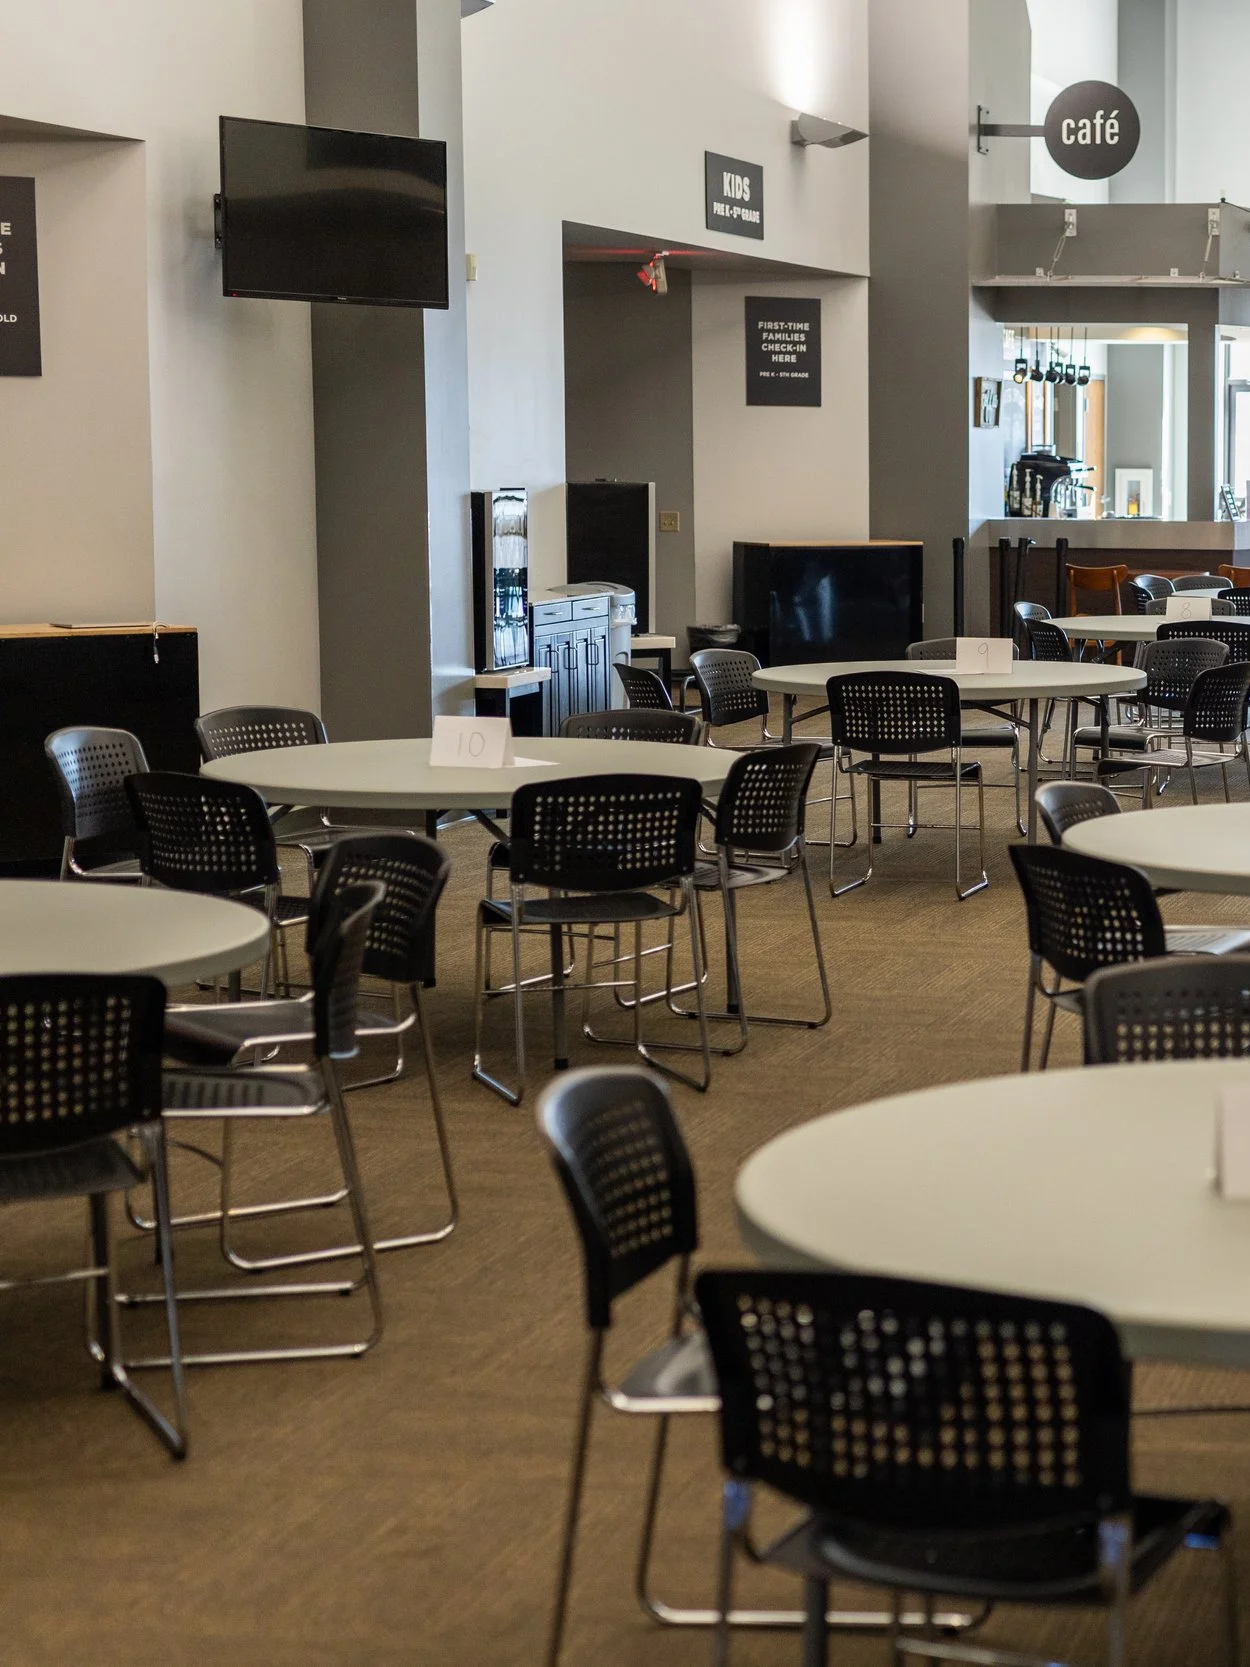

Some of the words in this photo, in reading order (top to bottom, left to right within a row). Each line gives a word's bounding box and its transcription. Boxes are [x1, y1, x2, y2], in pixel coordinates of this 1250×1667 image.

[1061, 109, 1120, 145] café
[723, 171, 750, 202] KIDS
[713, 201, 725, 216] PRE
[741, 207, 760, 223] GRADE
[758, 321, 810, 331] FIRST-TIME
[762, 332, 806, 342] FAMILIES
[761, 343, 807, 352] CHECK-IN
[771, 354, 797, 363] HERE
[790, 371, 809, 379] GRADE
[1181, 601, 1192, 620] 8
[978, 642, 989, 669] 9
[457, 731, 485, 758] 10
